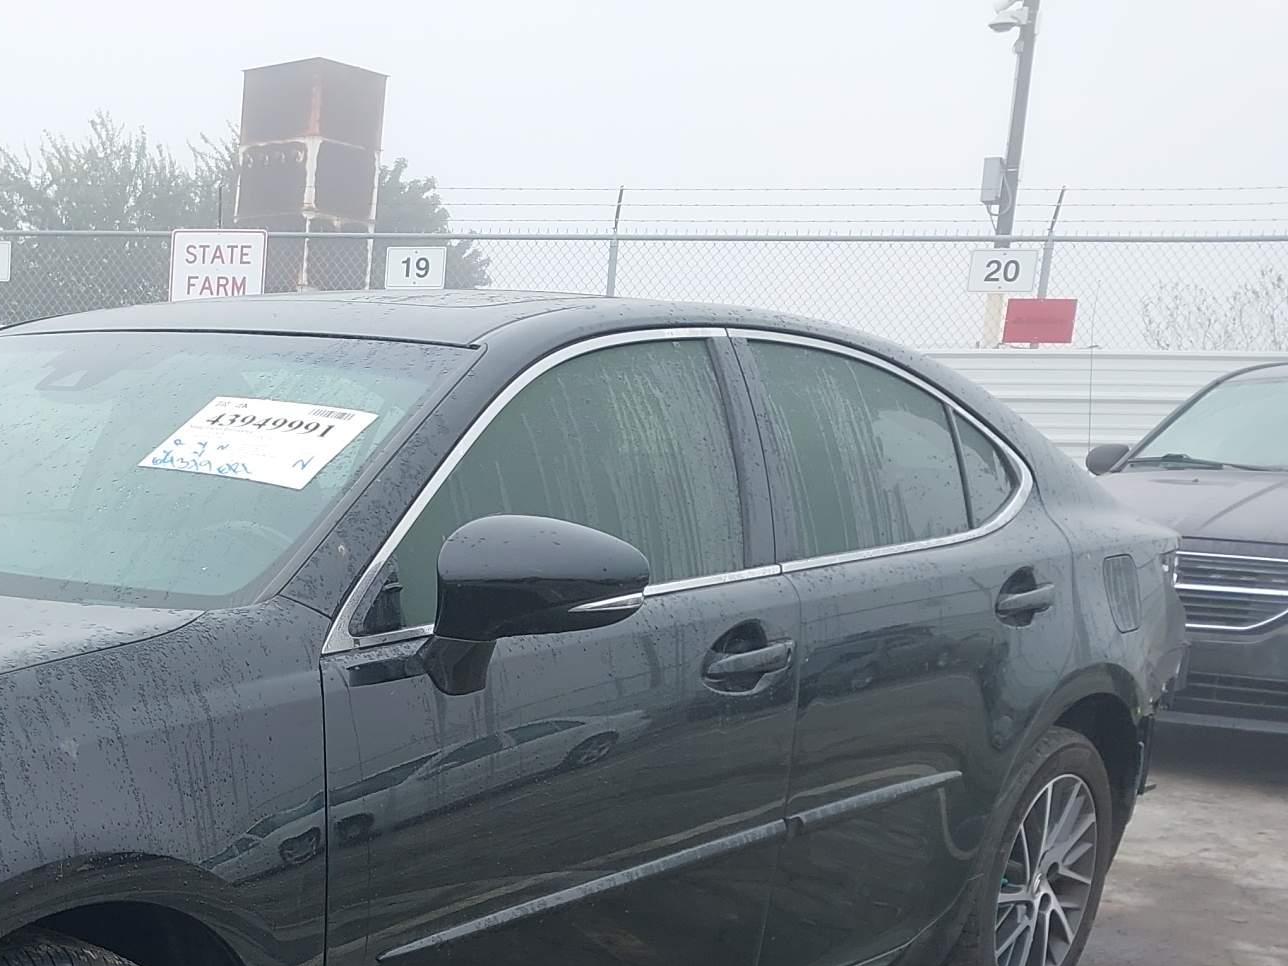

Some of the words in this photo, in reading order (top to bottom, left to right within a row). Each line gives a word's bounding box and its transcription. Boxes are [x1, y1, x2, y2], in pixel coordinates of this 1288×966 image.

[185, 244, 252, 265] STATE
[400, 251, 431, 279] 19
[983, 259, 1021, 283] 20
[185, 275, 249, 297] FARM
[206, 412, 335, 438] 43949991
